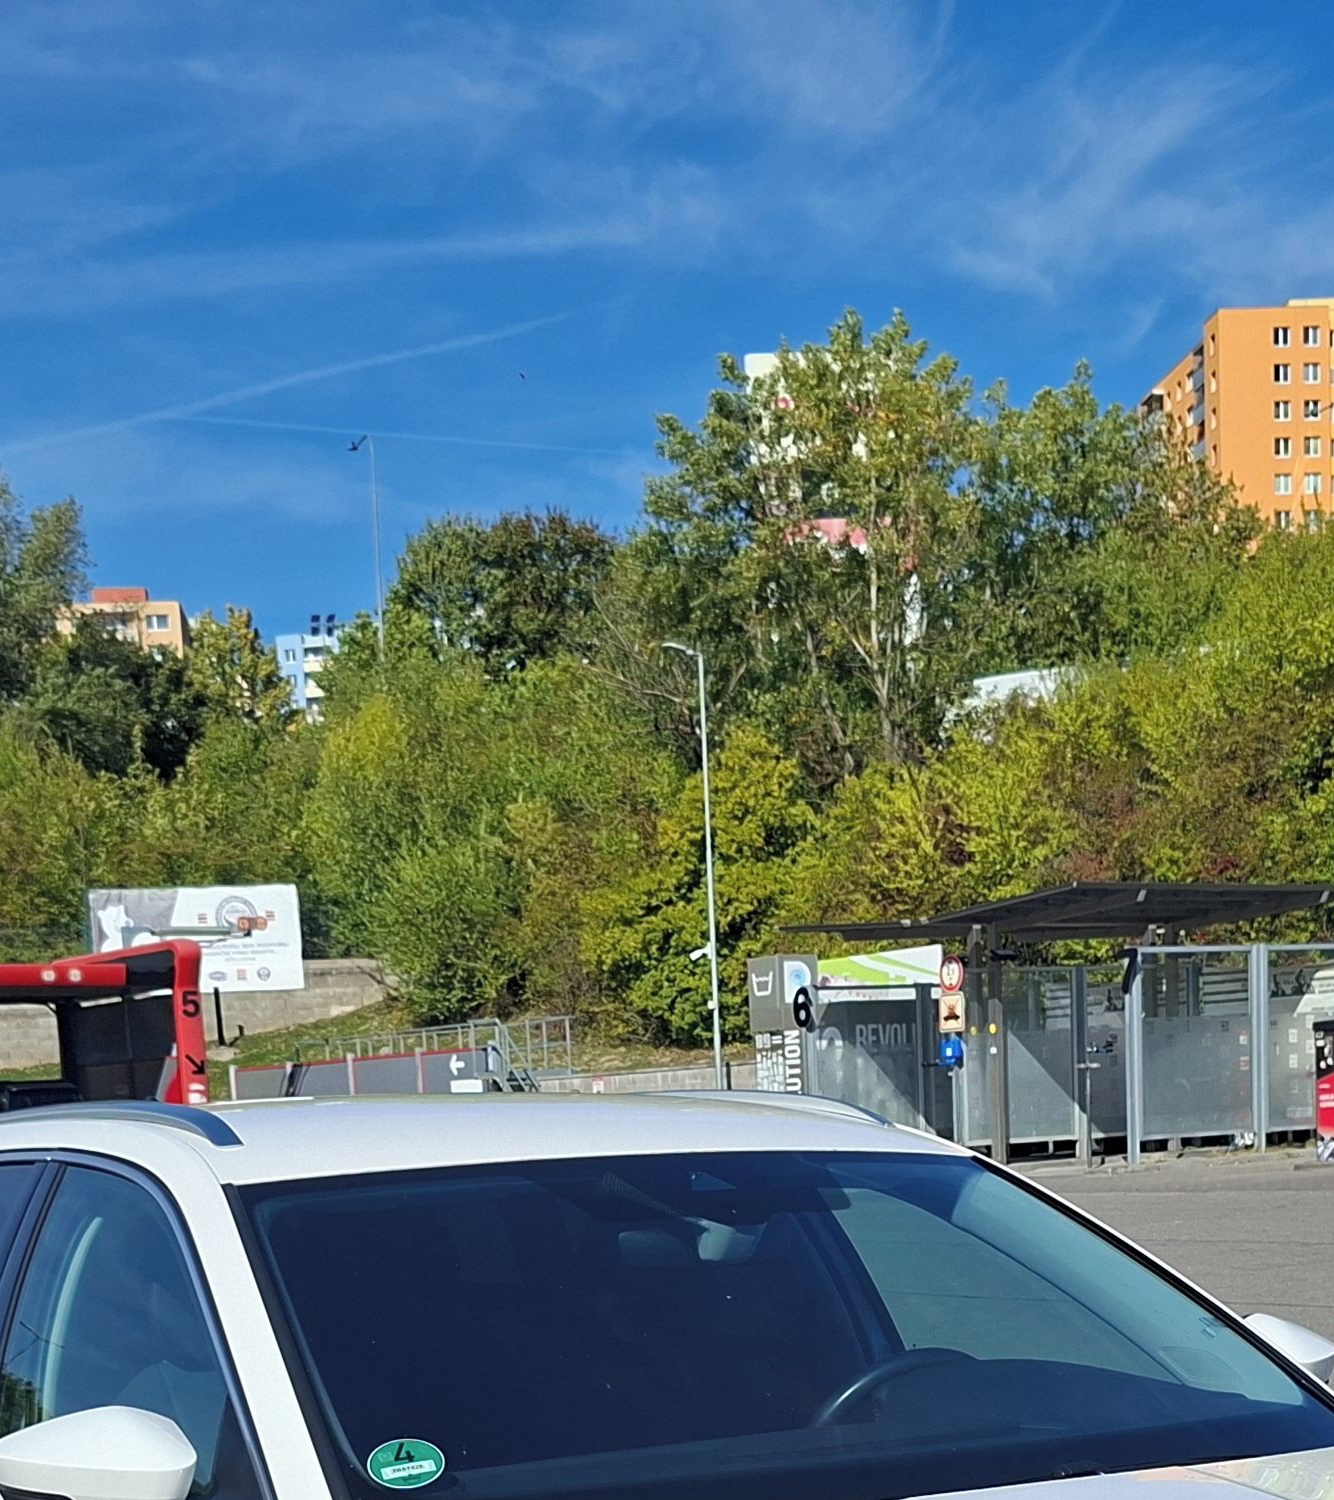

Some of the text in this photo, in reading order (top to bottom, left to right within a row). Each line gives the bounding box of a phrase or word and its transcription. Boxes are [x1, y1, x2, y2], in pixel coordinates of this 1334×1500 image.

[181, 990, 201, 1018] 5
[793, 986, 813, 1028] 6
[784, 1030, 802, 1095] UTION
[394, 1442, 415, 1461] 4
